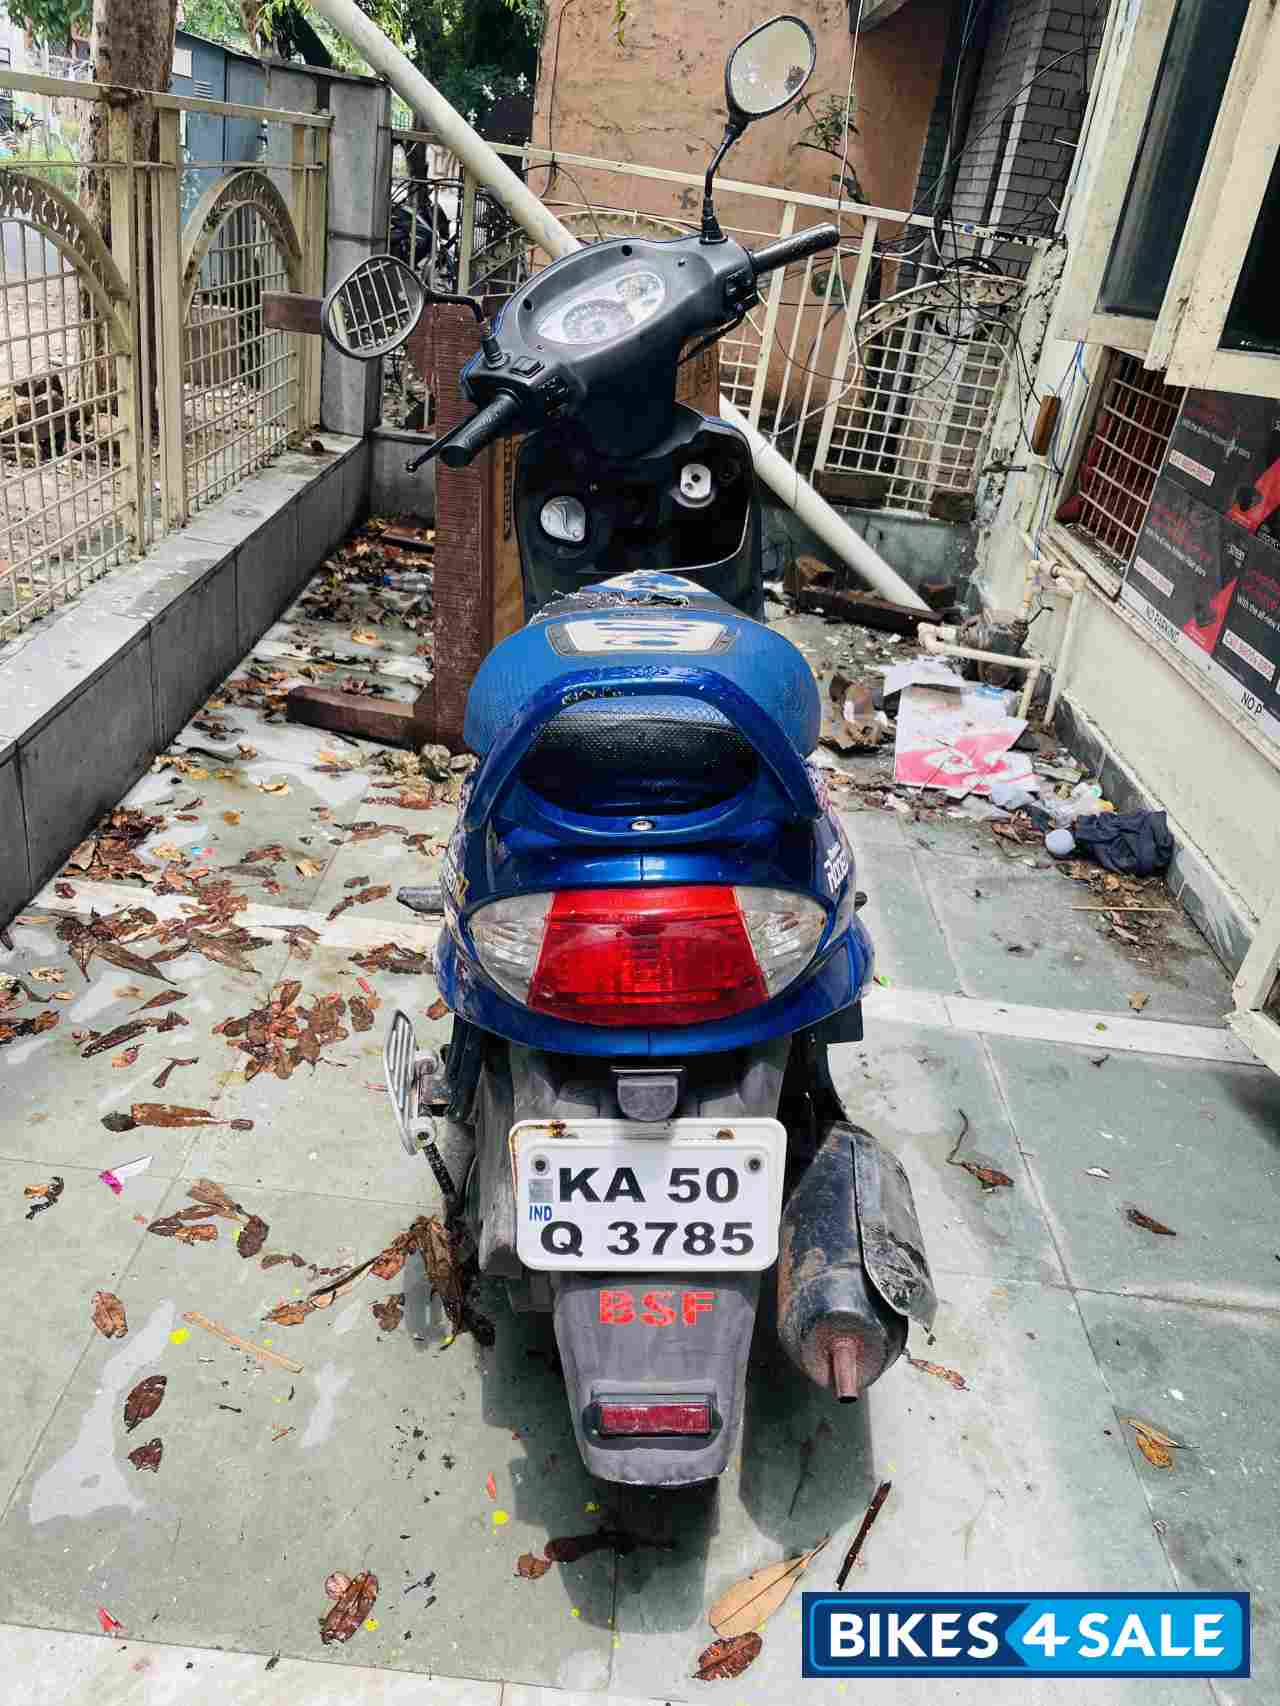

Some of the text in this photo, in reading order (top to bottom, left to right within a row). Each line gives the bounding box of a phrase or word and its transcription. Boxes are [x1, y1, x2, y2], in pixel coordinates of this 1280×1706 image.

[1241, 690, 1256, 710] NO
[559, 1167, 739, 1203] KA 50
[528, 1205, 553, 1221] IND
[540, 1221, 754, 1257] Q 3785
[598, 1290, 717, 1327] BSF
